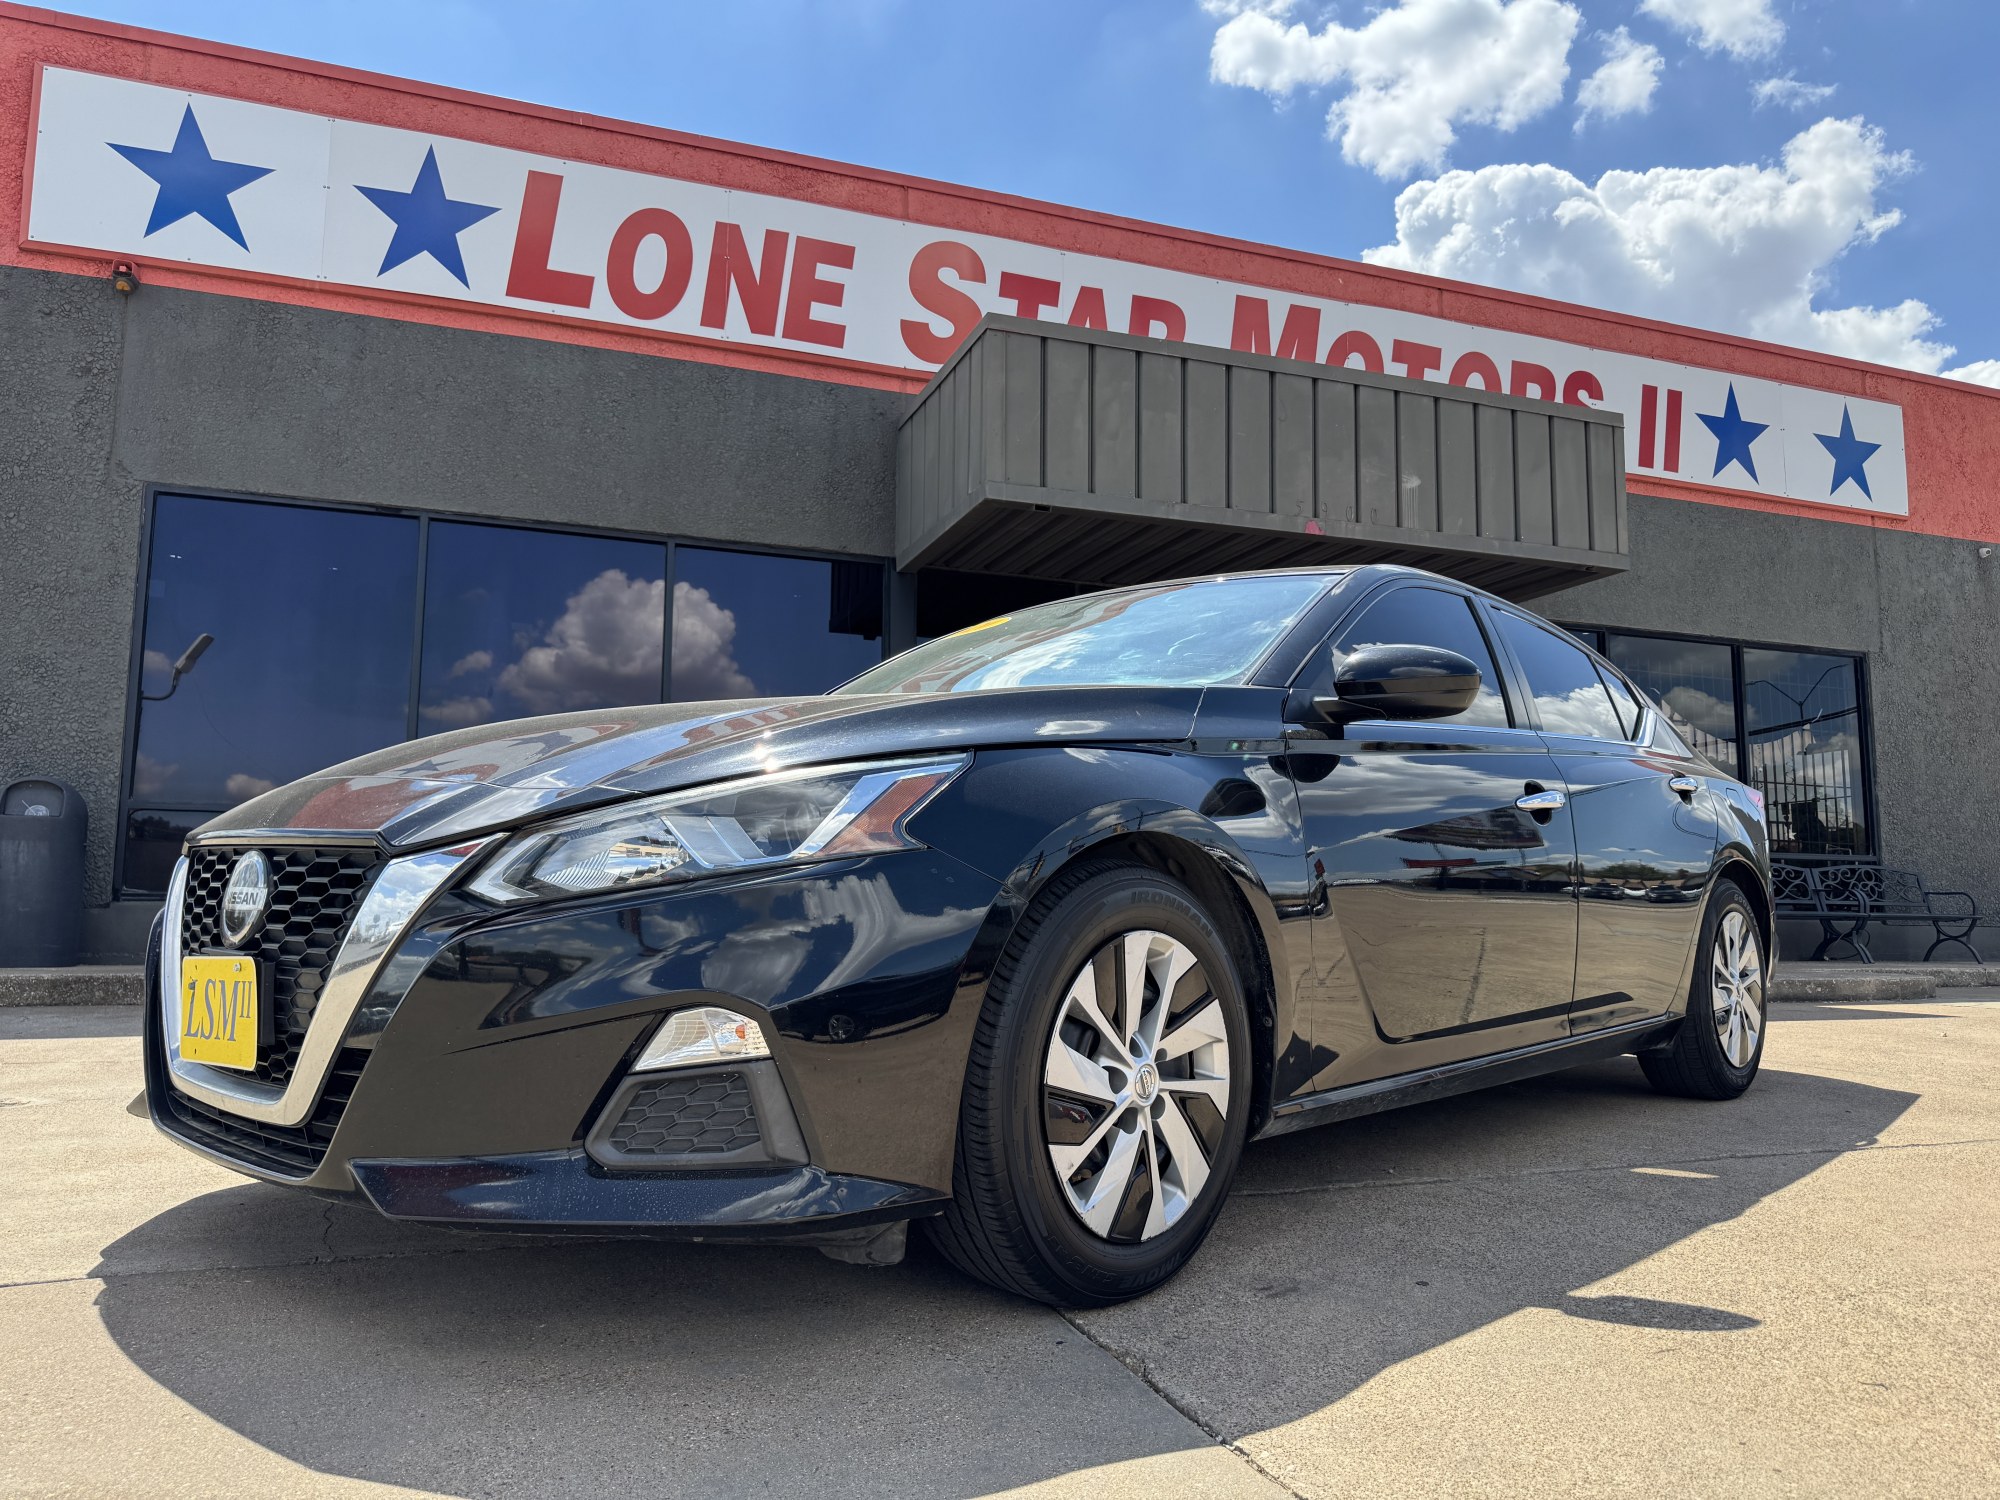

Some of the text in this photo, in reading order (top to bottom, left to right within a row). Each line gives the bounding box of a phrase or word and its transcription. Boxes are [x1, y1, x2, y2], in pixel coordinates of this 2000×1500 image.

[505, 169, 856, 349] LONE
[1638, 384, 1682, 473] II
[1130, 891, 1213, 938] IRONMAN
